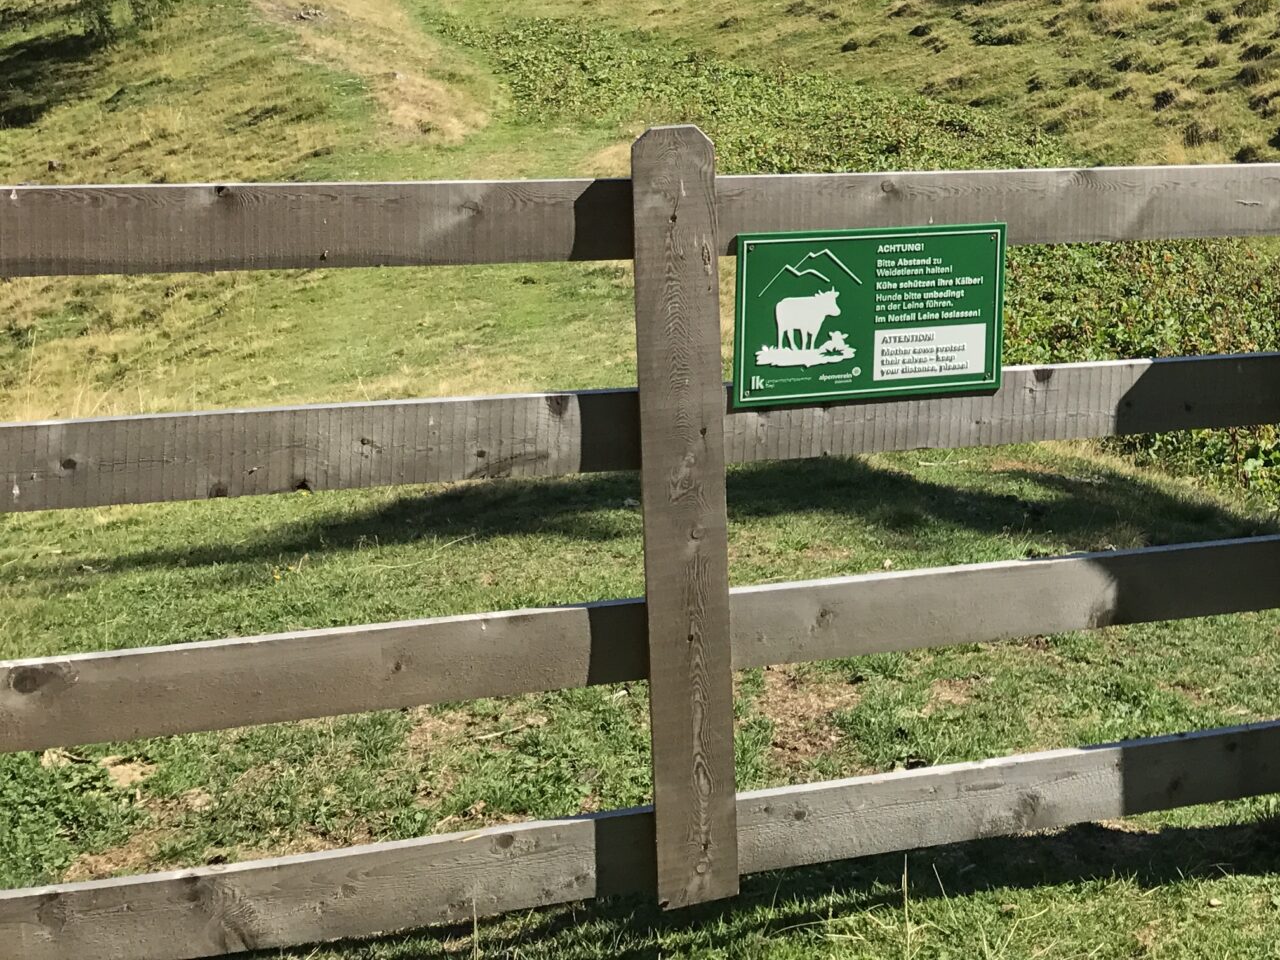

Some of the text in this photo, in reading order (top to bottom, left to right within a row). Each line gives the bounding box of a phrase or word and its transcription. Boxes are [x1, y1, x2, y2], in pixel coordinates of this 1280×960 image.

[877, 243, 924, 253] ACHTUNG!
[876, 257, 942, 268] Bitte Abstand zu
[876, 265, 953, 277] Weidetieren halten!
[876, 280, 897, 290] Kühe
[899, 279, 936, 289] schützen
[955, 276, 984, 285] Kälber!
[875, 289, 964, 302] Hunde bitte unbedingt
[875, 299, 954, 312] an der Leine führen.
[875, 309, 981, 323] Im Notfall Leine loslassen!
[881, 333, 935, 344] ATTENTION!
